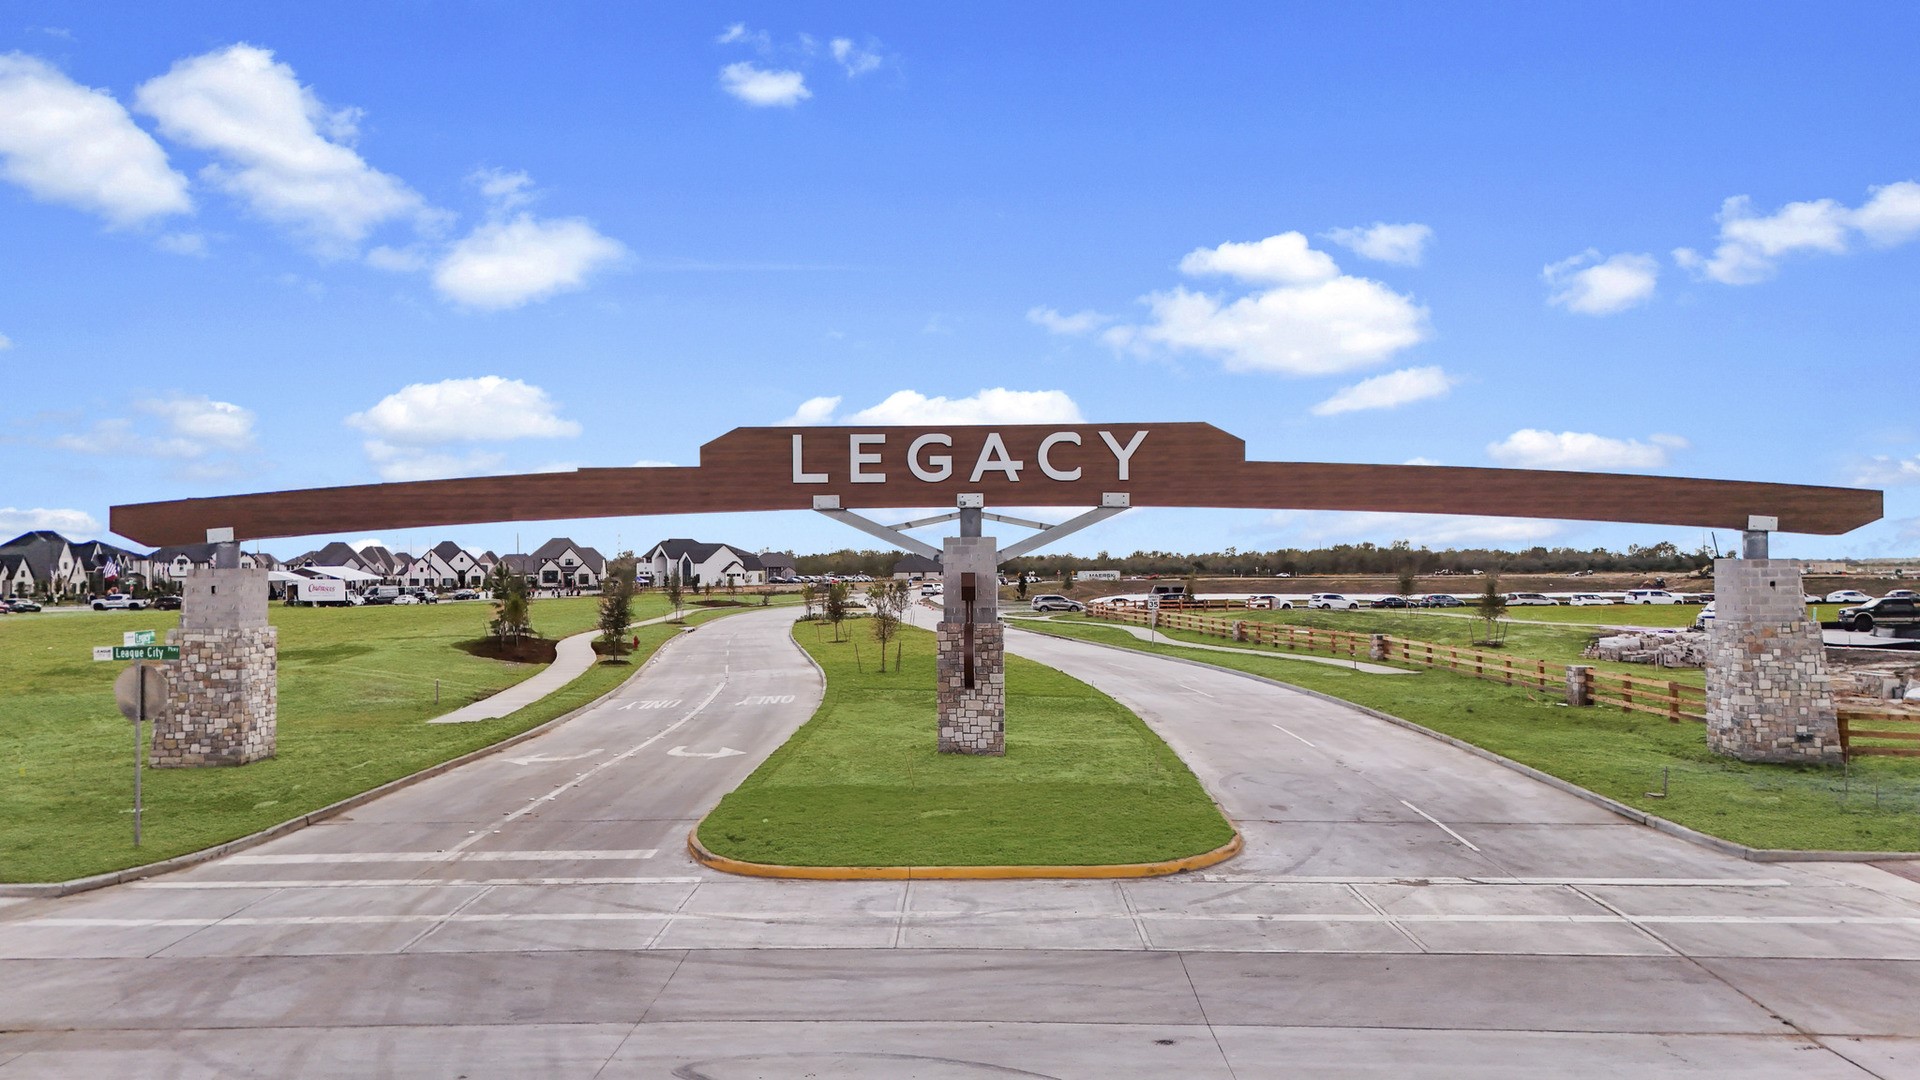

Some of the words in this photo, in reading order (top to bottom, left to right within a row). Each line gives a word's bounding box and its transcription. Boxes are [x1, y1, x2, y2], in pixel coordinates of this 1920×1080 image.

[792, 431, 1149, 484] LEGACY
[115, 647, 144, 659] League
[147, 646, 164, 659] City
[618, 700, 682, 711] ONLY
[735, 694, 796, 706] ONLY
